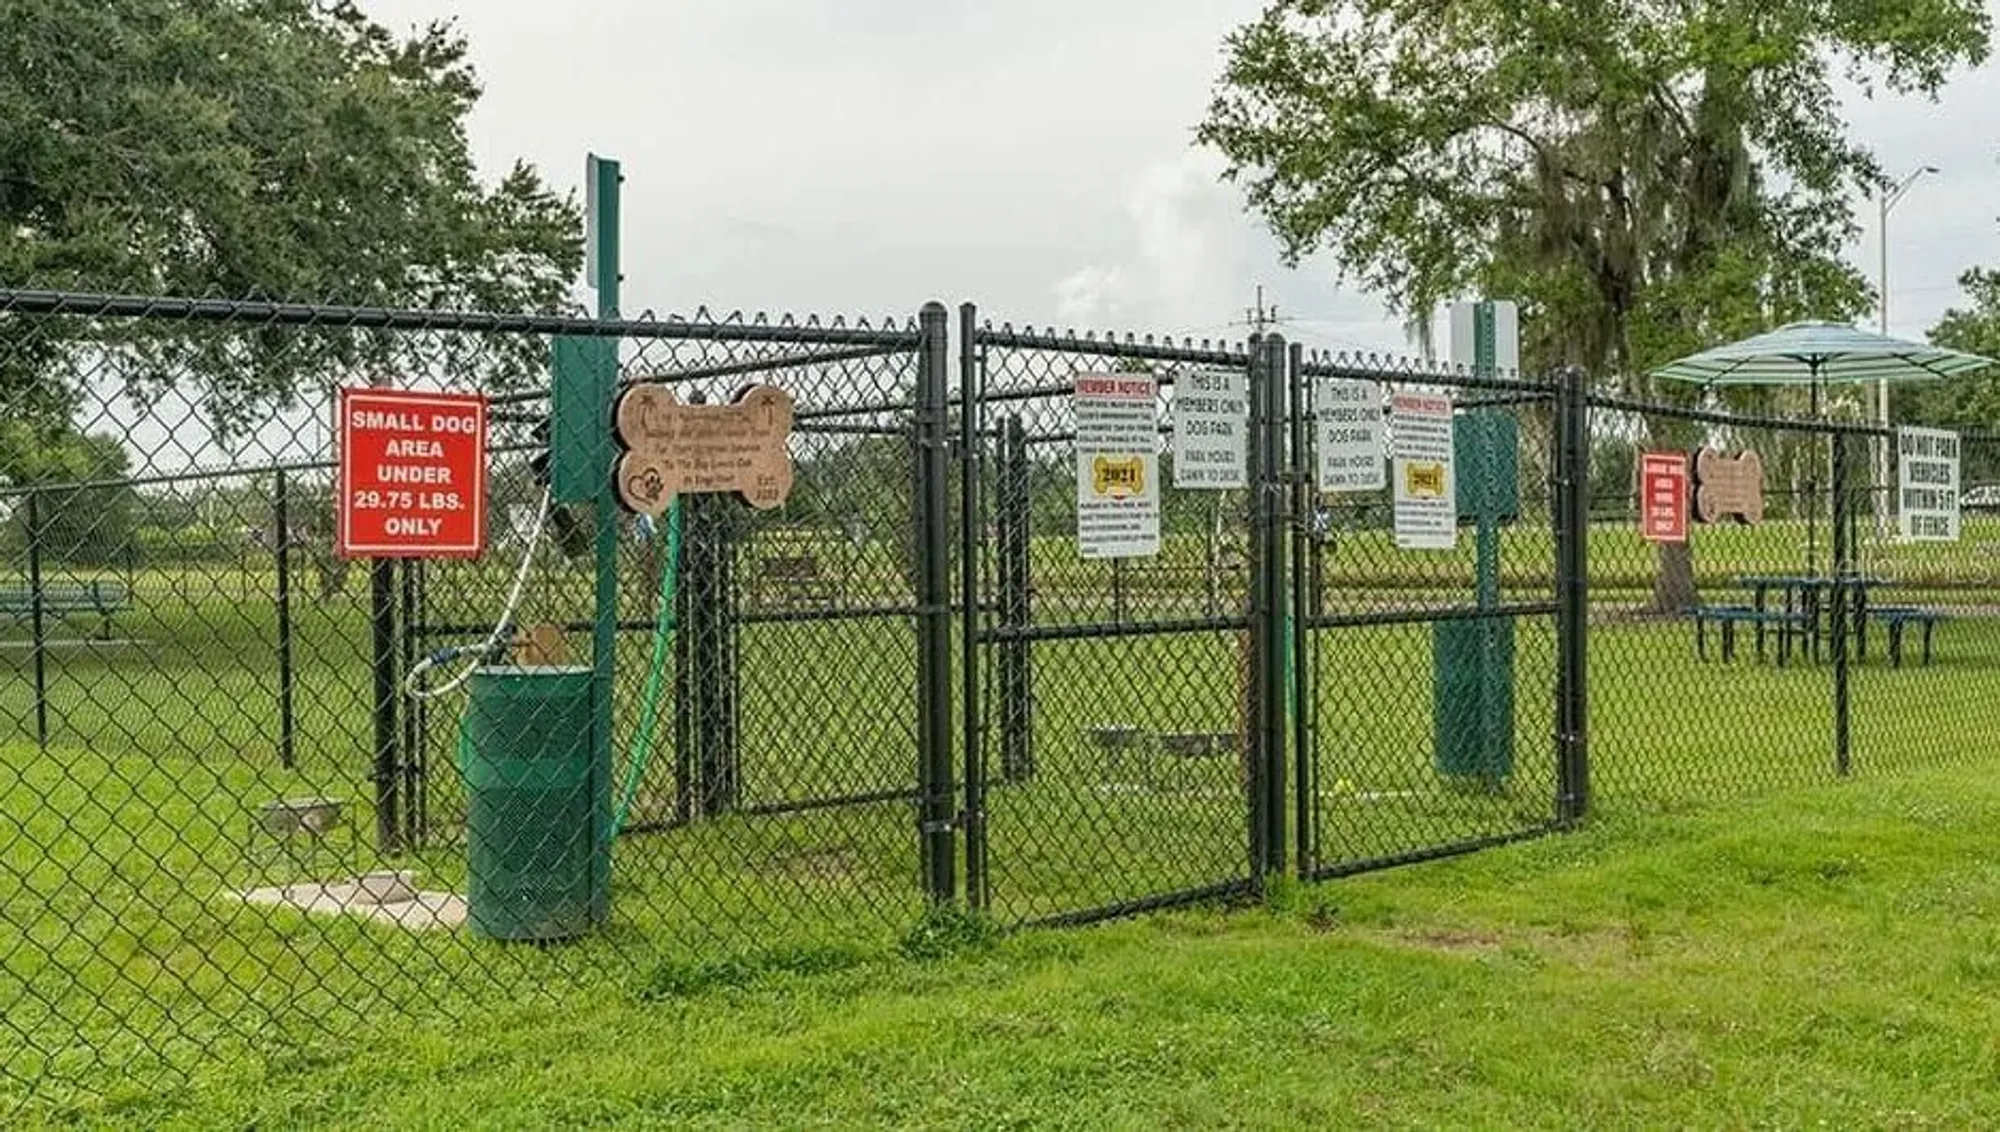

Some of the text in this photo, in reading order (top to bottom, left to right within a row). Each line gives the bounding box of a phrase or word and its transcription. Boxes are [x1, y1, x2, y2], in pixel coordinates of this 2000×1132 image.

[1078, 380, 1150, 395] MEMBER NOTICE
[1191, 373, 1210, 391] THIS
[1175, 397, 1244, 414] MEMBERS ONLY
[352, 411, 475, 434] SMALL DOG
[1319, 408, 1357, 422] MEMBERS
[1186, 420, 1233, 436] DOG PARK
[1328, 429, 1349, 443] DOG
[385, 439, 444, 457] AREA
[1901, 433, 1956, 458] DO NOT PARK
[377, 464, 452, 484] UNDER
[1103, 466, 1135, 483] 2021
[1413, 471, 1438, 486] 2021
[1909, 461, 1950, 485] VEHICLES
[354, 490, 466, 510] 29.75 LBS.
[1903, 488, 1955, 510] WITHIN 5 FT
[384, 517, 443, 535] ONLY
[1910, 515, 1950, 536] OF FENCE
